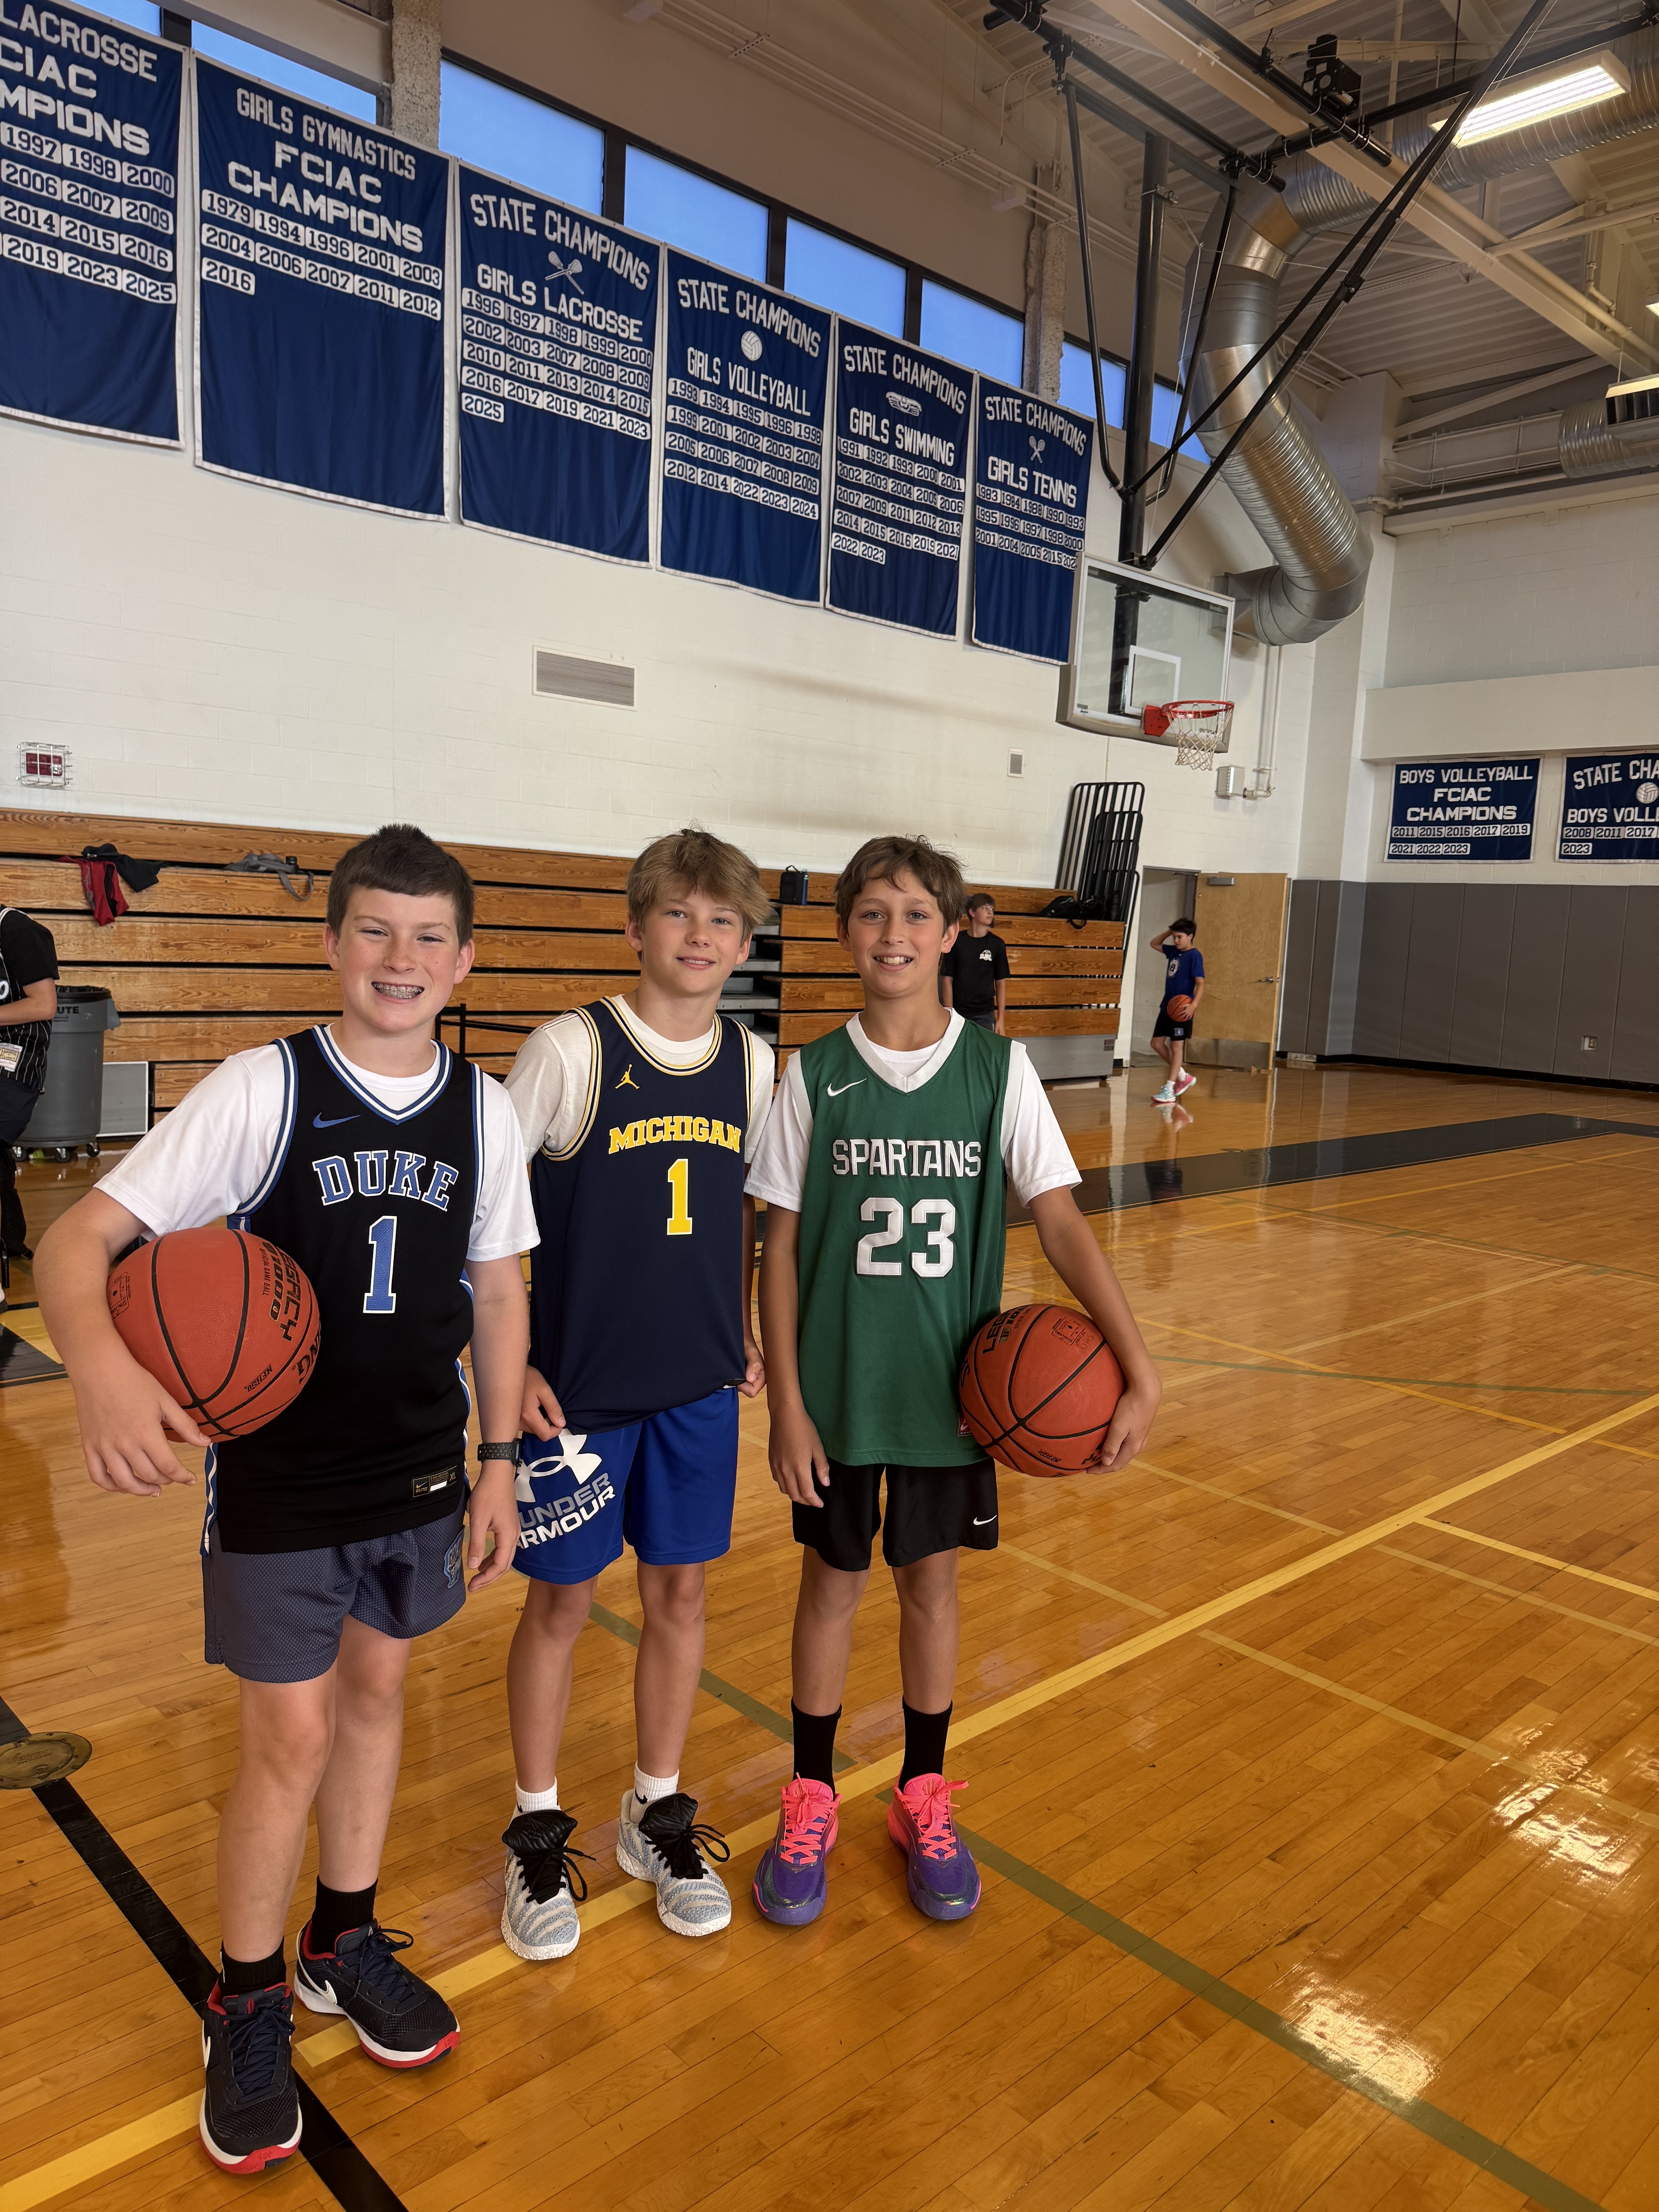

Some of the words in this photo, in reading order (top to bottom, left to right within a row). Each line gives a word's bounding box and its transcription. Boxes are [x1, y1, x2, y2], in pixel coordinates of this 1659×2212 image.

[0, 0, 157, 82] LACROSSE
[0, 36, 96, 98] CIAC
[0, 79, 149, 155] MPIONS
[237, 88, 293, 134] GIRLS
[303, 115, 415, 180] GYMNASTICS
[7, 127, 57, 159] 1997
[70, 148, 115, 179] 1998
[128, 166, 171, 194] 2000
[275, 139, 381, 203] FCIAC
[6, 163, 57, 196] 2006
[67, 184, 114, 214] 2007
[126, 201, 169, 230] 2009
[228, 160, 422, 252] CHAMPIONS
[5, 200, 55, 233] 2014
[66, 220, 114, 250] 2015
[125, 237, 167, 268] 2016
[208, 194, 250, 223] 1979
[259, 213, 300, 242] 1994
[310, 231, 349, 257] 1996
[359, 246, 395, 272] 2001
[404, 261, 439, 286] 2003
[471, 194, 536, 235] STATE
[545, 210, 650, 290] CHAMPIONS
[8, 238, 58, 269] 2019
[68, 256, 117, 286] 2023
[126, 273, 172, 301] 2025
[206, 261, 251, 290] 2016
[207, 227, 250, 257] 2004
[260, 246, 301, 274] 2006
[309, 263, 350, 289] 2007
[359, 279, 394, 304] 2011
[404, 293, 437, 317] 2012
[467, 291, 500, 316] 1996
[507, 307, 540, 330] 1997
[549, 320, 577, 343] 1998
[585, 333, 615, 355] 1999
[622, 349, 651, 367] 2000
[477, 264, 536, 305] GIRLS
[544, 287, 642, 343] LACROSSE
[678, 279, 729, 314] STATE
[736, 290, 821, 357] CHAMPIONS
[466, 318, 501, 342] 2002
[508, 332, 540, 356] 2003
[547, 344, 576, 367] 2007
[583, 357, 614, 378] 2008
[620, 369, 649, 389] 2009
[468, 343, 500, 367] 2010
[510, 357, 540, 380] 2011
[547, 369, 577, 391] 2013
[584, 380, 615, 402] 2014
[620, 392, 649, 414] 2015
[688, 347, 721, 385] GIRLS
[729, 362, 810, 416] VOLLEYBALL
[844, 345, 886, 375] STATE
[893, 354, 966, 414] CHAMPIONS
[465, 396, 501, 419] 2025
[466, 369, 501, 393] 2016
[508, 382, 539, 405] 2017
[547, 394, 577, 416] 2019
[584, 405, 613, 427] 2021
[620, 416, 647, 438] 2023
[672, 380, 697, 402] 1993
[703, 392, 729, 413] 1994
[737, 403, 761, 423] 1995
[768, 414, 792, 434] 1996
[798, 424, 821, 443] 1998
[985, 397, 1022, 422] STATE
[1026, 403, 1086, 455] CHAMPIONS
[669, 434, 696, 455] 2005
[702, 445, 729, 464] 2006
[735, 454, 758, 473] 2007
[764, 464, 789, 484] 2008
[795, 474, 817, 493] 2009
[672, 407, 697, 426] 1999
[702, 418, 728, 438] 2001
[736, 428, 760, 450] 2002
[766, 439, 791, 459] 2003
[796, 449, 819, 468] 2004
[850, 407, 889, 444] GIRLS
[895, 424, 954, 466] SWIMMING
[668, 461, 695, 481] 2012
[701, 471, 728, 490] 2014
[734, 479, 758, 500] 2022
[762, 490, 788, 509] 2023
[793, 499, 816, 517] 2024
[840, 463, 861, 481] 2002
[866, 472, 887, 489] 2003
[891, 481, 912, 498] 2004
[940, 497, 963, 512] 2006
[867, 448, 887, 466] 1992
[892, 457, 912, 474] 1993
[941, 474, 961, 490] 2001
[988, 456, 1028, 491] GIRLS
[1033, 471, 1077, 509] TENNIS
[837, 511, 858, 530] 2014
[864, 520, 885, 539] 2015
[890, 530, 911, 547] 2016
[838, 487, 860, 505] 2007
[865, 496, 886, 514] 2009
[891, 505, 910, 522] 2011
[939, 520, 961, 534] 2013
[977, 507, 997, 523] 1995
[1022, 522, 1042, 537] 1997
[1045, 529, 1063, 544] 1998
[1065, 536, 1082, 550] 2000
[978, 485, 998, 501] 1983
[1046, 507, 1063, 522] 1990
[834, 535, 857, 553] 2022
[862, 544, 884, 562] 2023
[976, 529, 996, 545] 2001
[999, 537, 1018, 552] 2004
[1021, 543, 1041, 557] 2005
[1043, 549, 1062, 563] 2015
[1400, 770, 1434, 783] BOYS
[1441, 766, 1533, 783] VOLLEYBALL
[1434, 787, 1491, 802] FCIAC
[1573, 763, 1622, 789] STATE
[1394, 828, 1414, 836] 2011
[1420, 828, 1443, 836] 2015
[1447, 827, 1470, 836] 2016
[1474, 826, 1498, 836] 2017
[1503, 825, 1527, 835] 2019
[1407, 806, 1517, 821] CHAMPIONS
[1565, 828, 1591, 837] 2008
[1596, 828, 1621, 838] 2011
[1627, 828, 1654, 837] 2017
[1567, 808, 1607, 823] BOYS
[1392, 844, 1413, 853] 2021
[1417, 845, 1441, 854] 2022
[1444, 844, 1468, 854] 2023
[1563, 844, 1589, 854] 2023
[608, 1116, 741, 1154] MICHIGAN
[833, 1139, 981, 1177] SPARTANS
[312, 1150, 459, 1211] DUKE
[667, 1159, 692, 1235] 1
[363, 1216, 397, 1313] 1
[857, 1197, 955, 1278] 23
[262, 1282, 270, 1295] BALL
[276, 1247, 301, 1341] EGACY
[519, 1473, 610, 1528] UNDER
